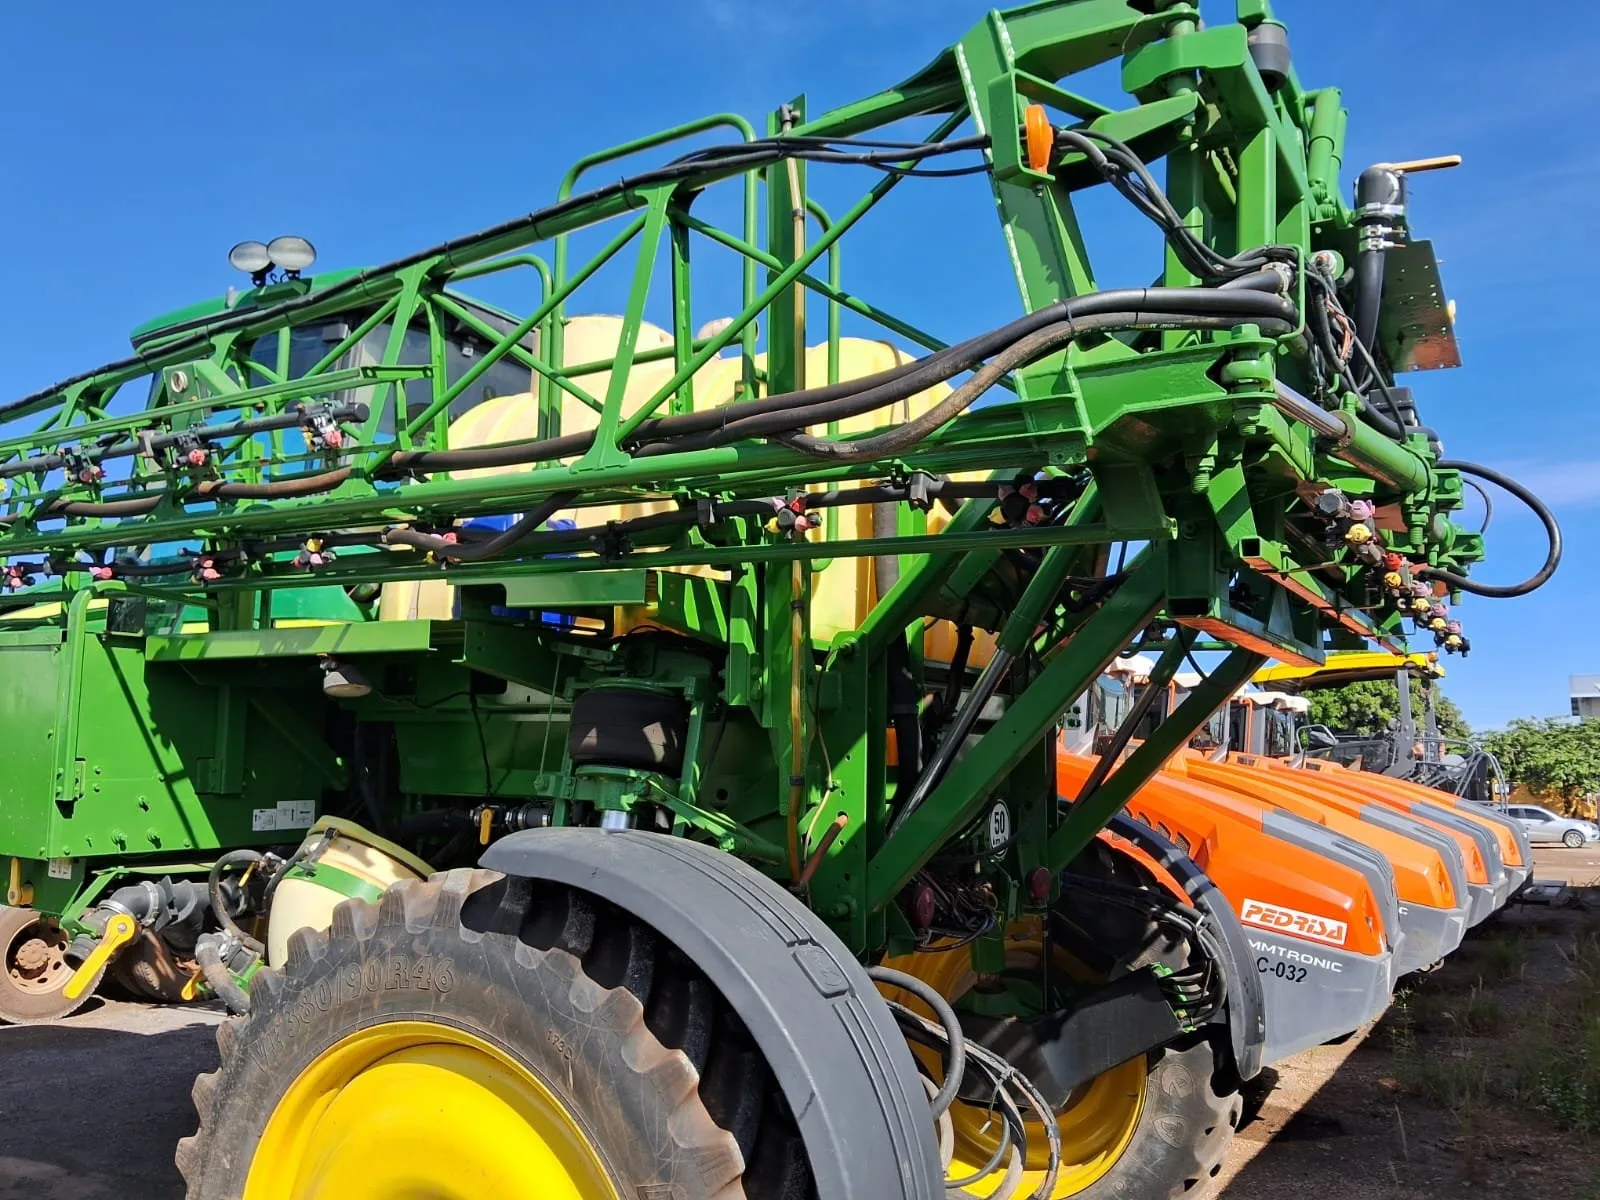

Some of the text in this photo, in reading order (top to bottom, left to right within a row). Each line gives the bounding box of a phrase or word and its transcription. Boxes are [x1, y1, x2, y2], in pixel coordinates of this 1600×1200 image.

[994, 810, 1005, 835] 50
[1256, 956, 1308, 983] C-032
[285, 954, 455, 1038] 380/90R46
